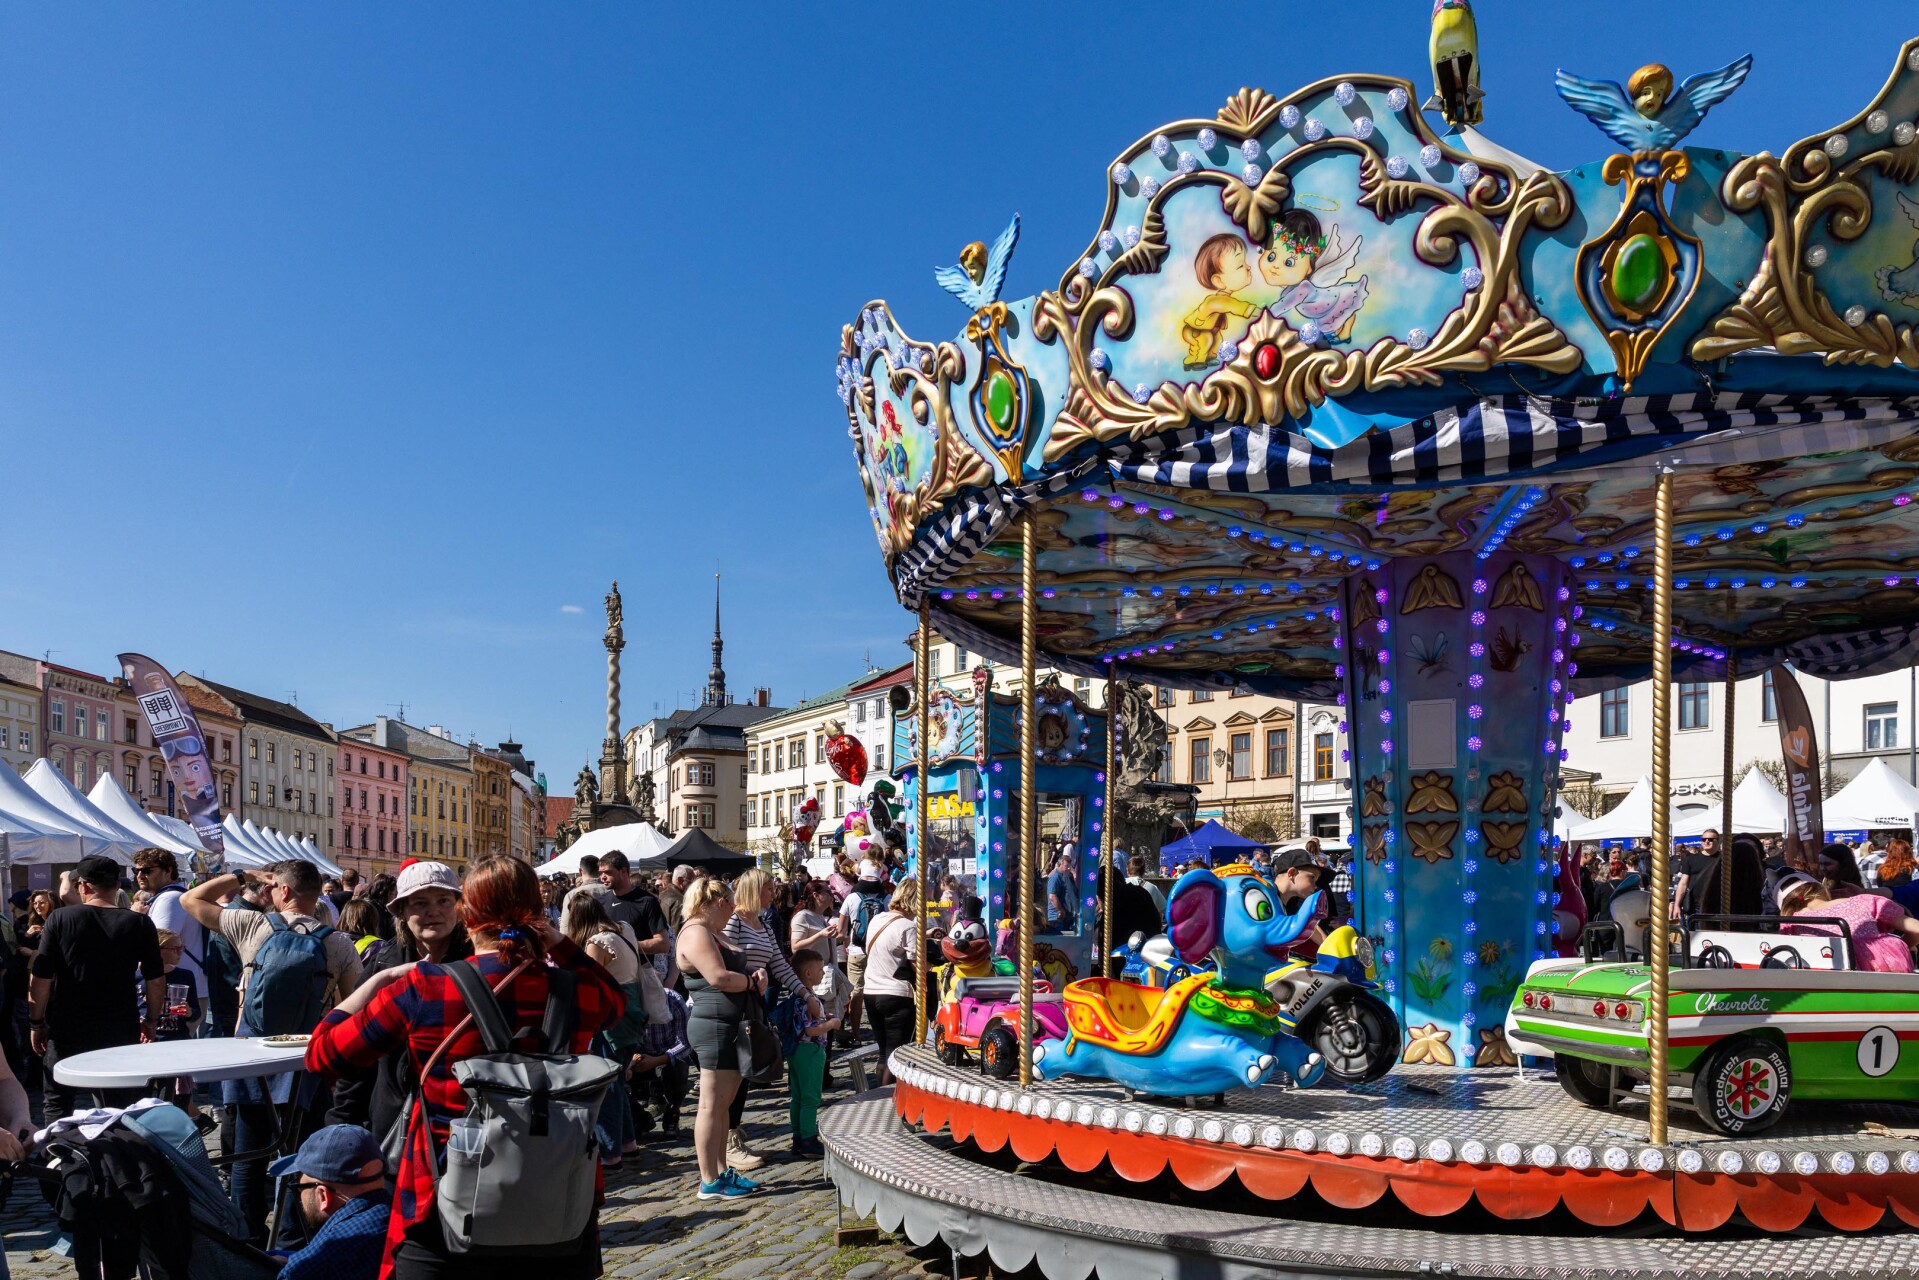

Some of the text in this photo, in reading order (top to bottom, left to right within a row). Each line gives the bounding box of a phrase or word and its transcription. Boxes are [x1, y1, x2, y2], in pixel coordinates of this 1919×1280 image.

[927, 793, 975, 820] KASA
[1791, 772, 1813, 842] kofola
[1288, 978, 1323, 1017] POLICIE
[1695, 991, 1771, 1013] Chevrolet
[1871, 1034, 1883, 1068] 1
[1768, 1052, 1789, 1112] Radial T/A
